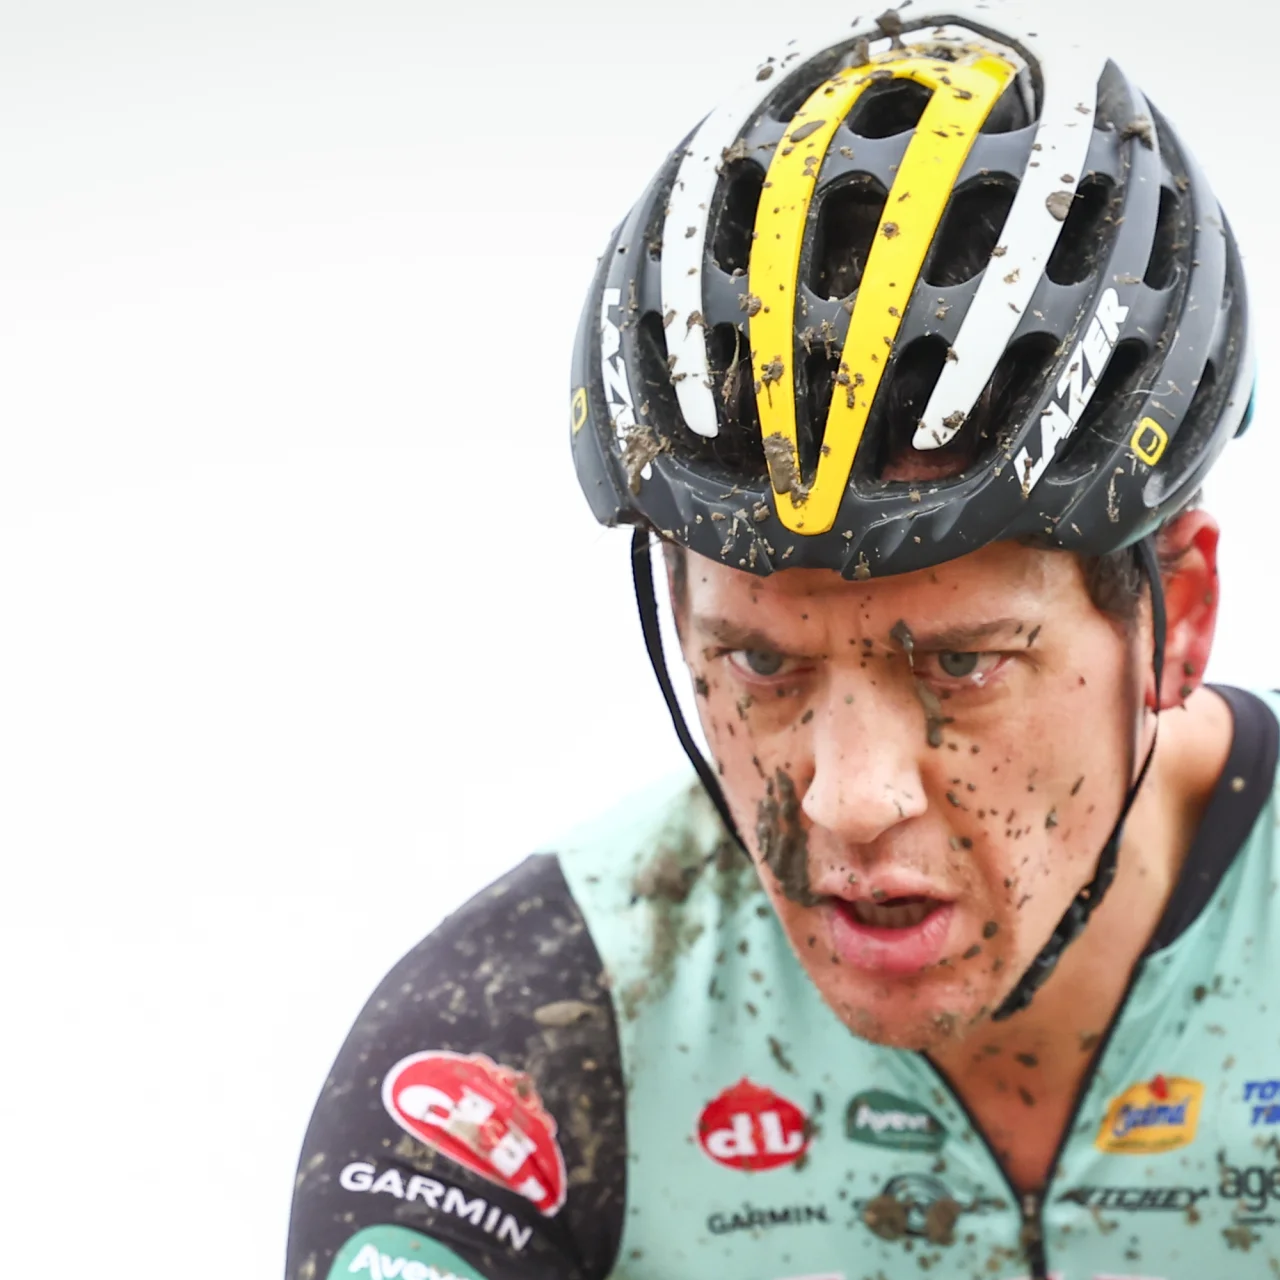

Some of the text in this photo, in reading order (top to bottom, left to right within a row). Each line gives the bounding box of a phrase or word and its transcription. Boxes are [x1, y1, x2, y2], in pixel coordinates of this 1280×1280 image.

[1013, 287, 1130, 496] LAZER
[340, 1161, 534, 1250] GARMIN
[708, 1203, 829, 1234] GARMIN
